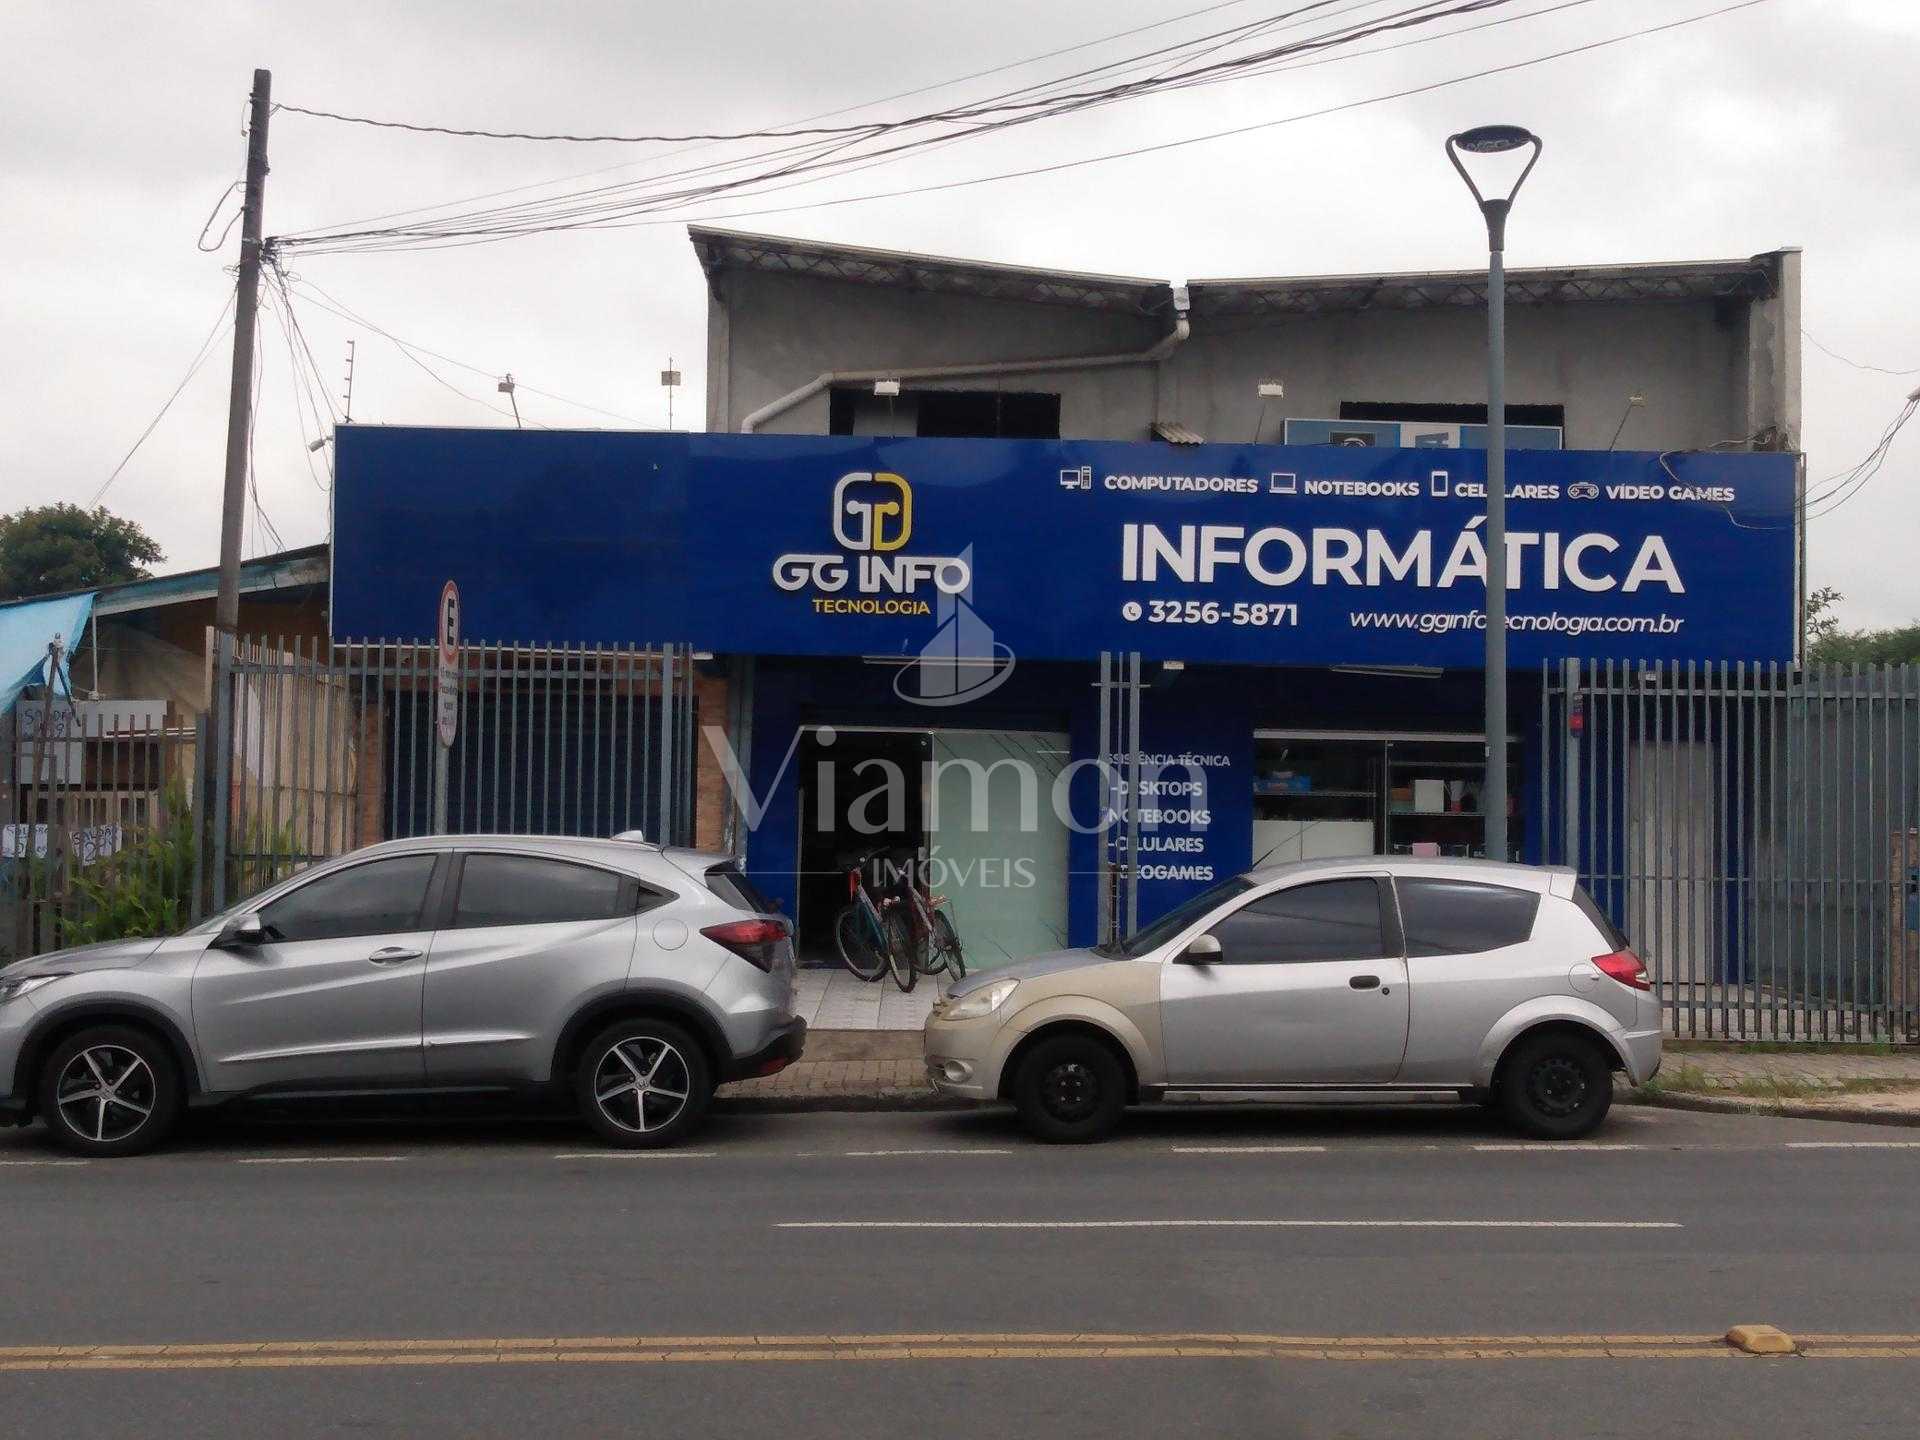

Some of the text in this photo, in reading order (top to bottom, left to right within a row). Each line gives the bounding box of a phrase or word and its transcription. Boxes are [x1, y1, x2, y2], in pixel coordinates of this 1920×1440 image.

[1104, 474, 1259, 494] COMPUTADORES
[1304, 480, 1420, 497] NOTEBOOKS
[1454, 483, 1560, 499] CELARES
[1605, 482, 1735, 502] VÍDEO GAMES
[1122, 515, 1686, 594] INFORMÁTICA
[773, 554, 970, 594] GG INFO
[812, 598, 931, 615] TECNOLOGIA
[1148, 600, 1298, 627] 3256-5871
[1349, 609, 1685, 636] www.gginfocnologia.com.br
[1179, 751, 1231, 767] TÉCNICA
[1111, 780, 1203, 797] -DSKTOPS
